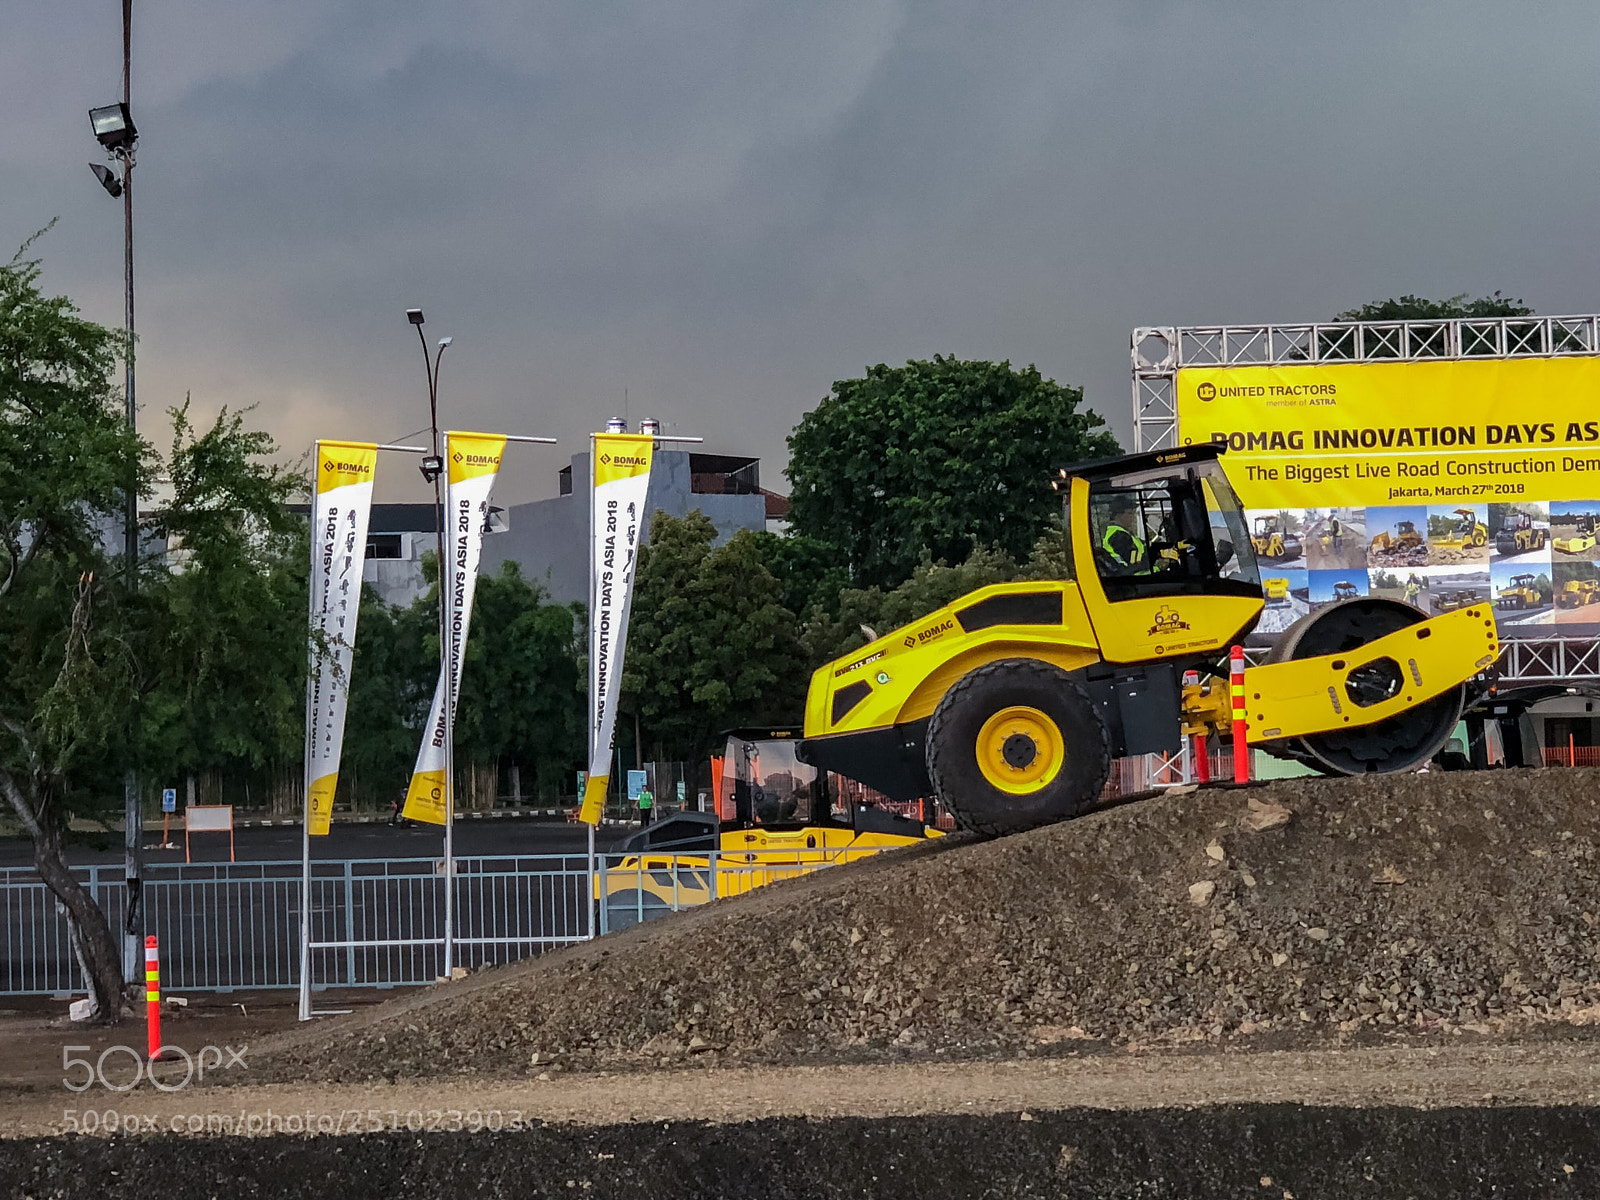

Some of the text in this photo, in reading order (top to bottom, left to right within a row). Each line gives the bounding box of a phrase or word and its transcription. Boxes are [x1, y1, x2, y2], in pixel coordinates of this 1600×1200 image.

[1219, 384, 1336, 398] UNITED TRACTORS
[1309, 398, 1336, 406] ASTRA
[1313, 426, 1475, 449] INNOVATION
[1486, 423, 1556, 444] DAYS
[337, 462, 370, 474] BOMAG
[466, 454, 500, 465] BOMAG
[614, 456, 647, 466] BOMAG
[1245, 465, 1278, 481] The
[1285, 464, 1349, 483] Biggest
[1356, 462, 1390, 478] Live
[1397, 460, 1440, 477] Road
[1446, 458, 1555, 475] Construction
[1388, 483, 1525, 500] Jakarta, March 27th 2018
[326, 507, 338, 541] 2018
[459, 499, 470, 534] 2018
[607, 500, 618, 534] 2018
[323, 543, 334, 576] ASIA
[457, 535, 468, 570] ASIA
[604, 535, 616, 569] ASIA
[454, 571, 466, 607] DAYS
[601, 571, 613, 608] DAYS
[917, 620, 954, 641] BOMAG
[451, 609, 463, 697] INNOVATION
[598, 609, 611, 697] INNOVATION
